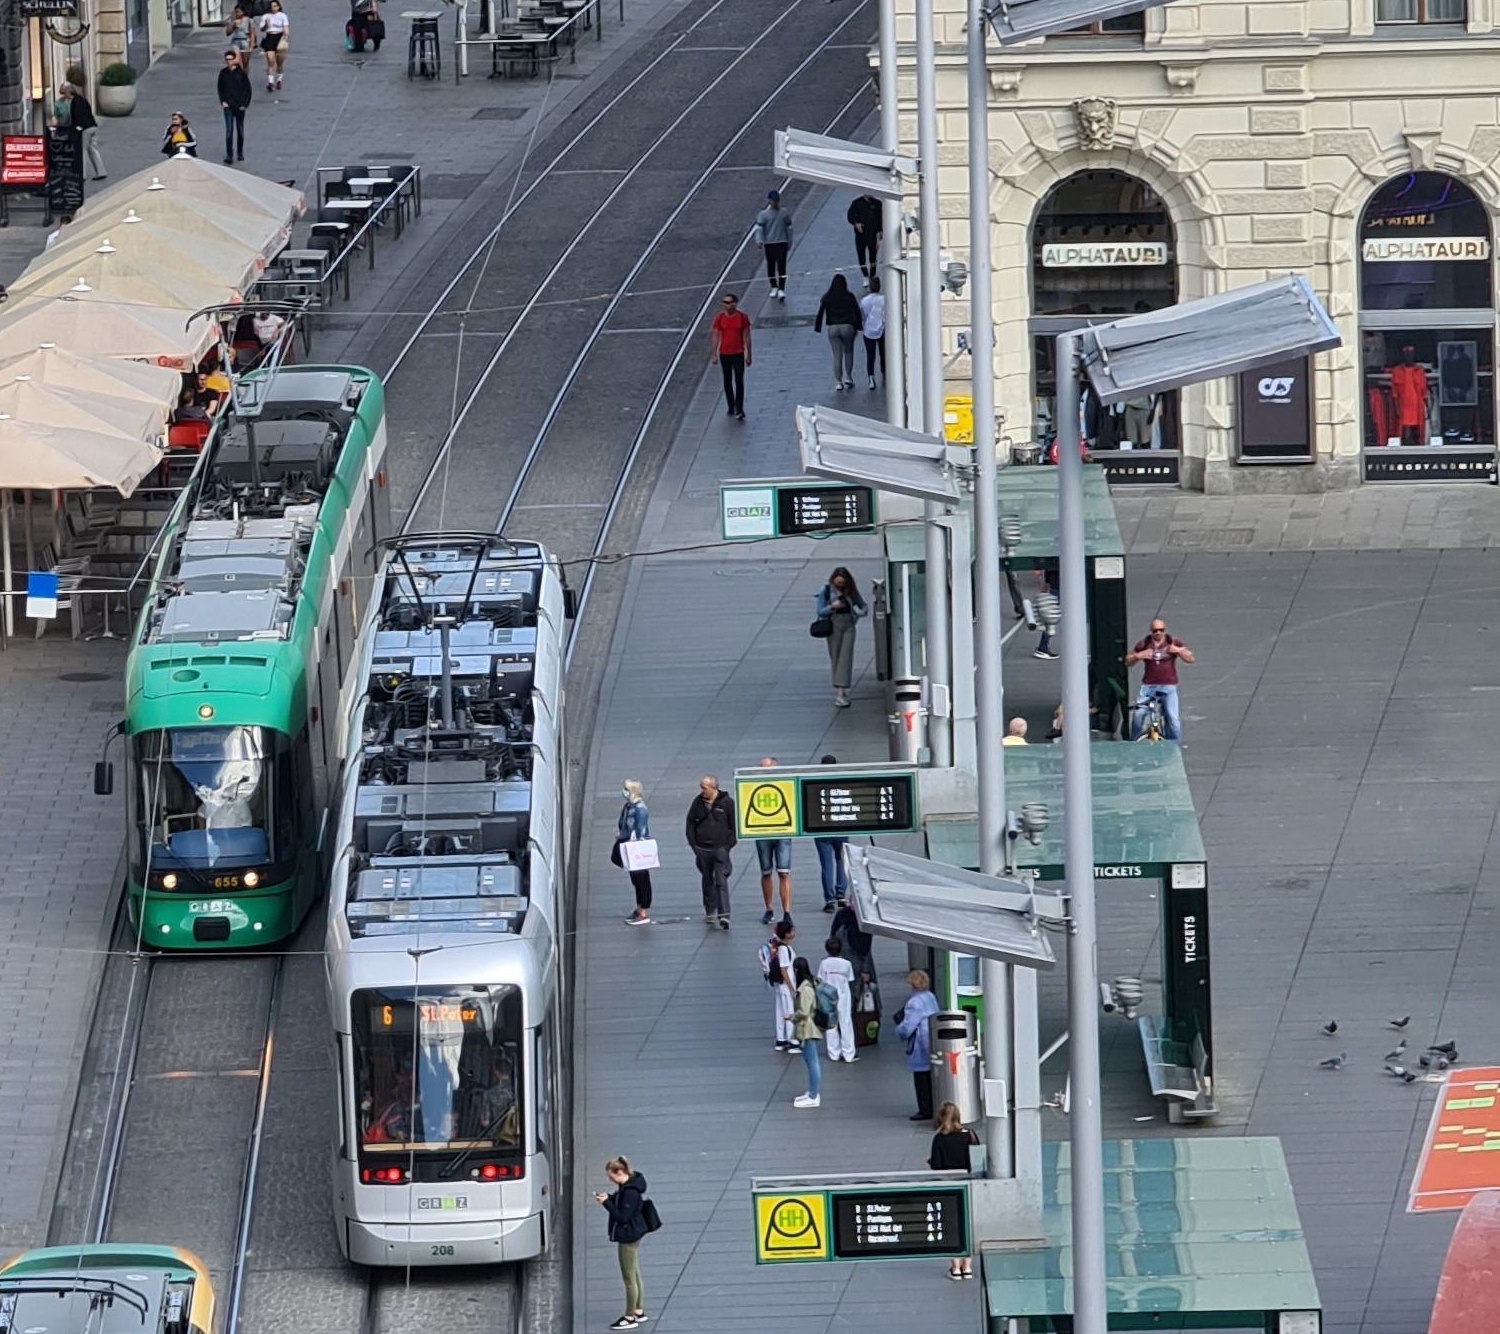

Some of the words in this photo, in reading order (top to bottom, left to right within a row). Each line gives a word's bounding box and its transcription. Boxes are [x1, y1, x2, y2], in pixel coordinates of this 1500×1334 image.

[1044, 247, 1163, 264] ALPHATAURI
[1366, 241, 1485, 259] ALPHATAURI
[727, 507, 771, 517] GRAZ
[758, 790, 779, 808] HH
[1094, 865, 1142, 877] TICKETS
[214, 876, 239, 888] 655
[1184, 915, 1196, 963] TICKETS
[382, 1005, 393, 1026] 6
[778, 1209, 805, 1227] HH
[431, 1245, 455, 1256] 208
